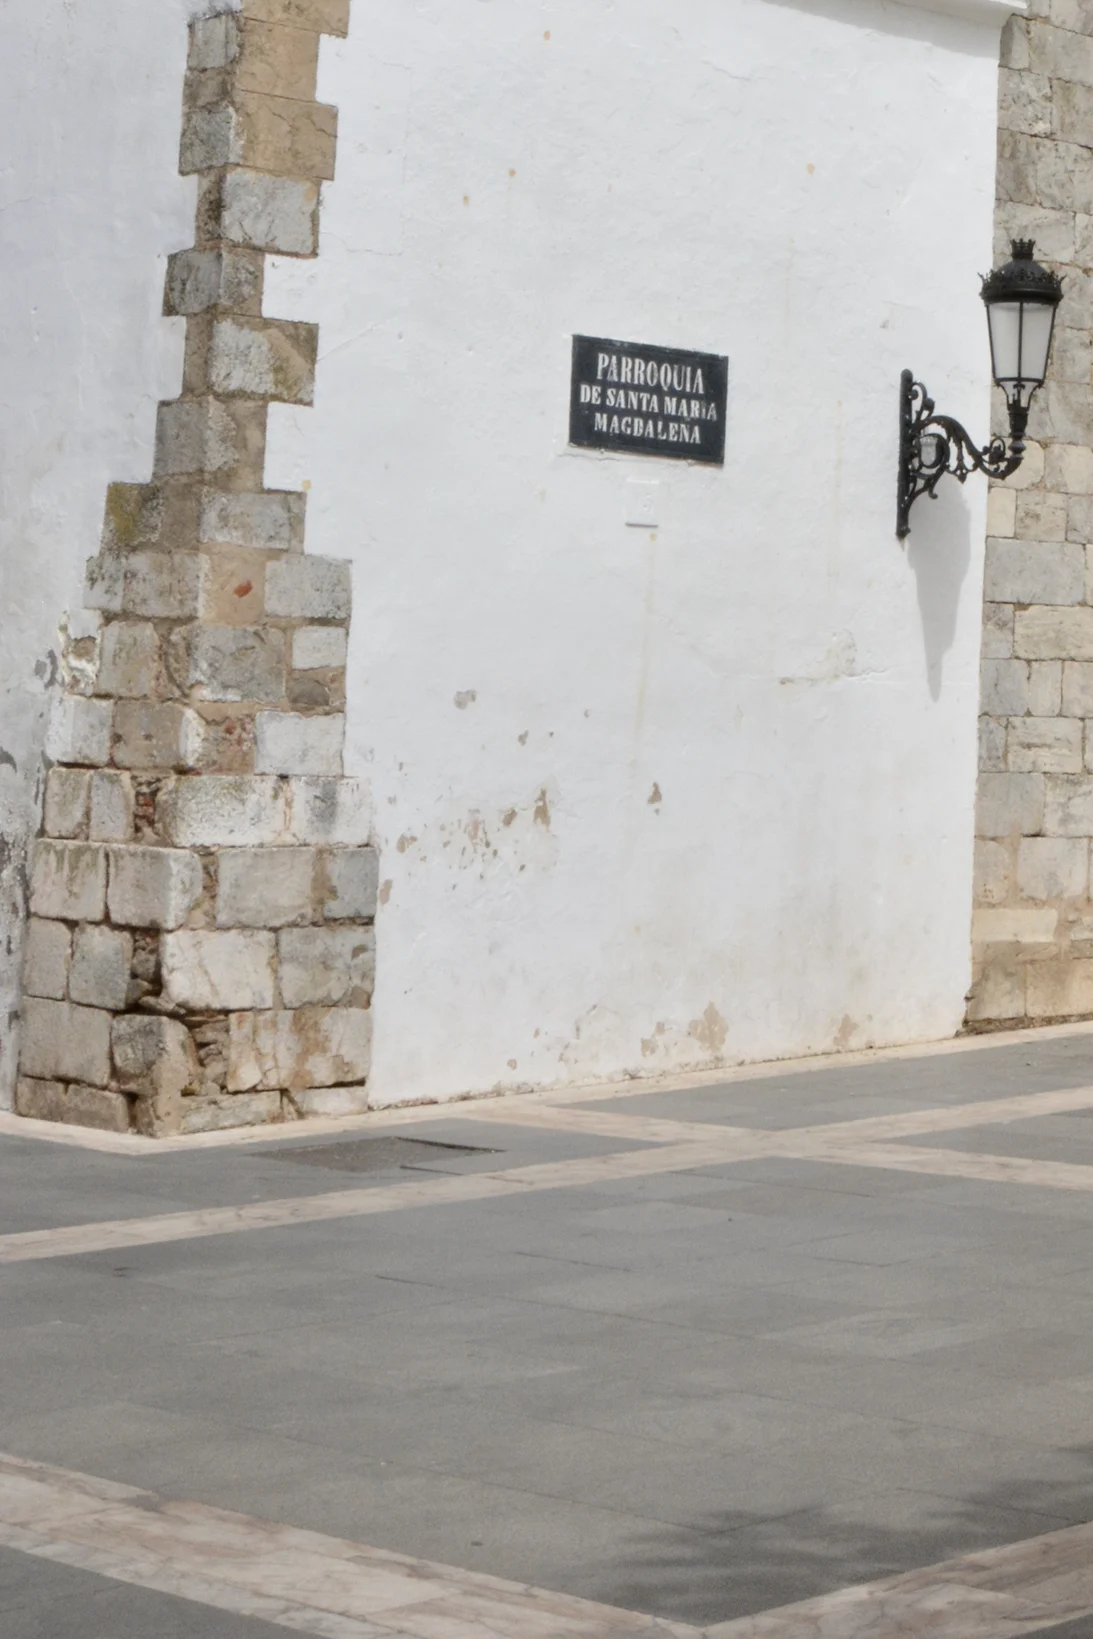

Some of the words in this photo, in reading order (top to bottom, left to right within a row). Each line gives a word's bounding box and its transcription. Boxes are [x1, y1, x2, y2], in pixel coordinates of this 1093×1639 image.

[596, 352, 705, 395] PARROQUIA
[580, 383, 602, 405] DE
[606, 387, 659, 413] SANTA
[594, 412, 702, 444] MAGDALENA
